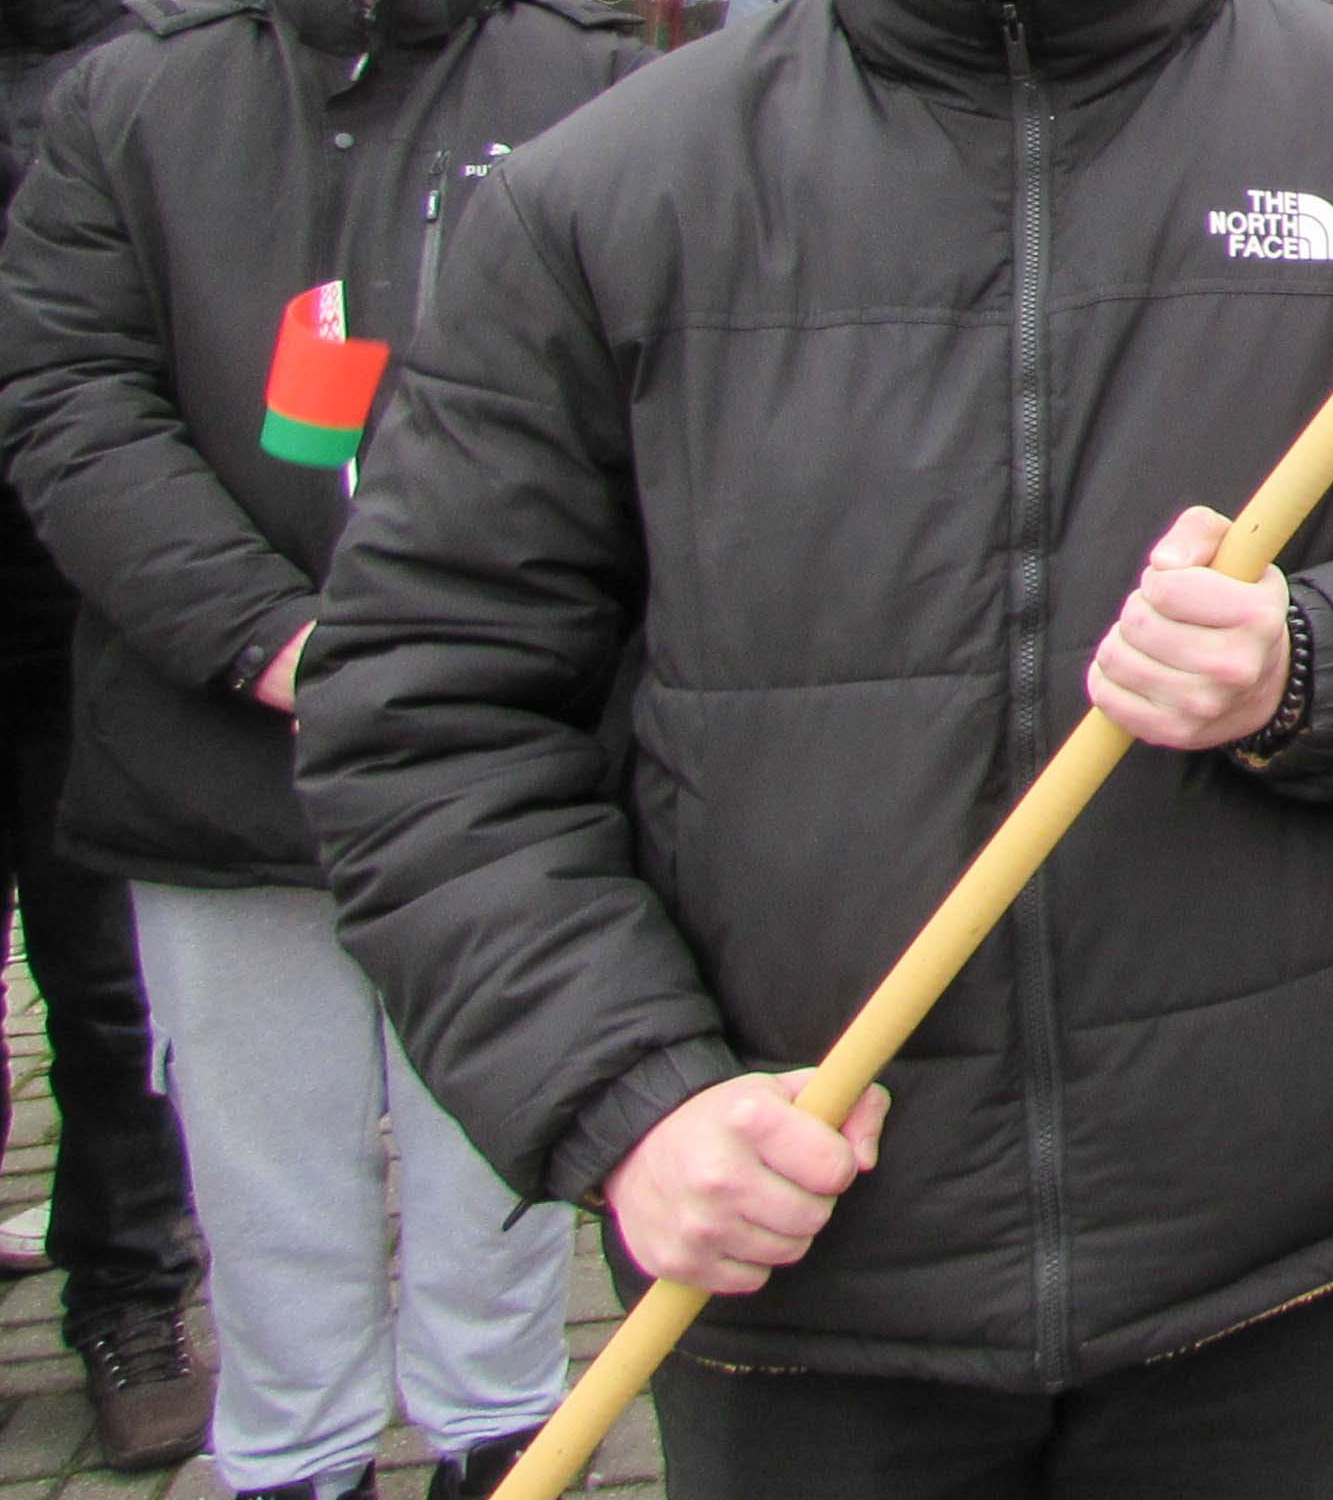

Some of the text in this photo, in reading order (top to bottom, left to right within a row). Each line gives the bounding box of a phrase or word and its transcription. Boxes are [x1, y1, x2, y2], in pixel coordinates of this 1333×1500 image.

[464, 164, 492, 177] PU
[1247, 189, 1298, 214] THE
[1208, 210, 1299, 237] NORTH
[1228, 234, 1299, 260] FACE
